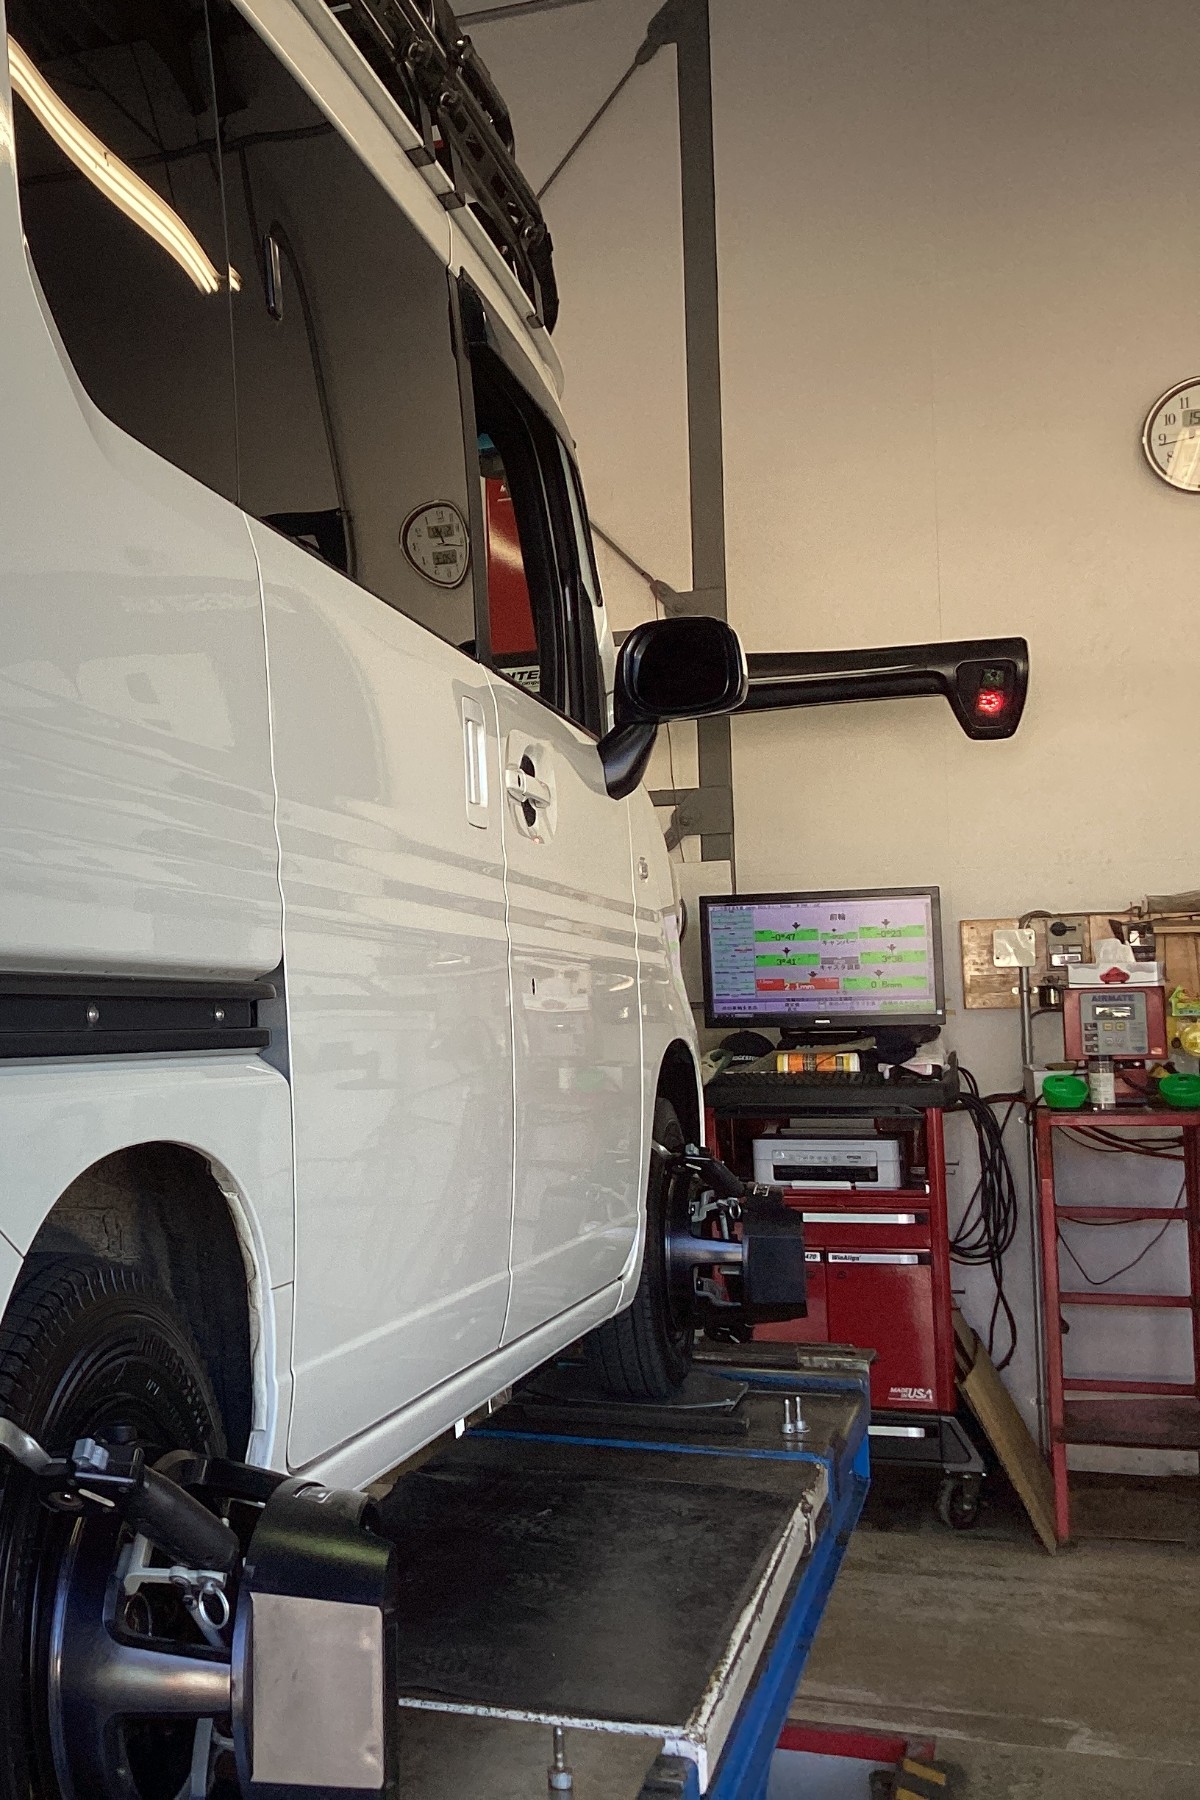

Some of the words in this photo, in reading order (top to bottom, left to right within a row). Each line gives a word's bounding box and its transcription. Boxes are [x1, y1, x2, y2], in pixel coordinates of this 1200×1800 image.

[1180, 397, 1190, 409] 11
[1164, 413, 1176, 426] 10
[506, 670, 540, 681] NTE
[908, 1388, 933, 1400] USA
